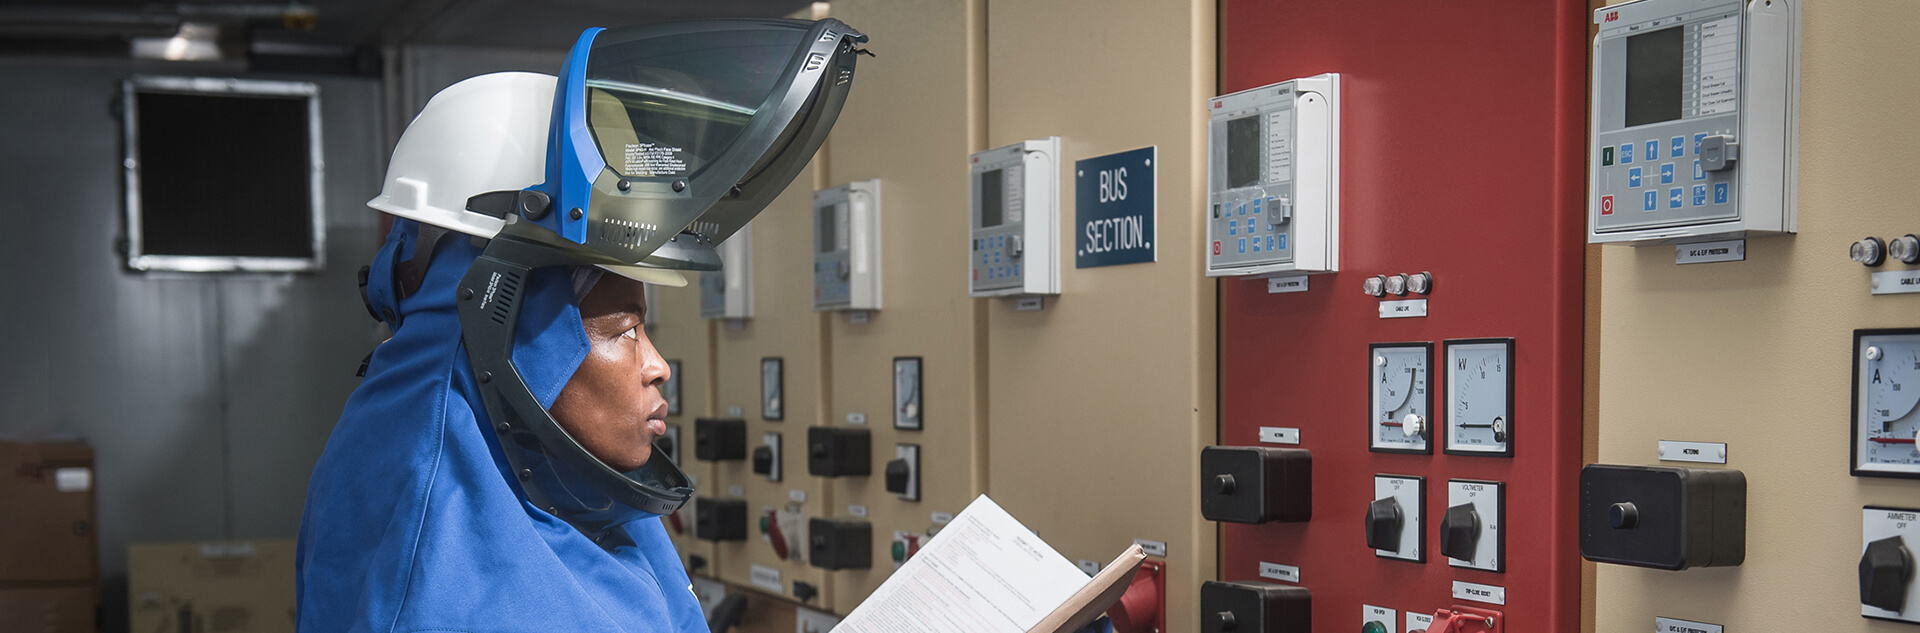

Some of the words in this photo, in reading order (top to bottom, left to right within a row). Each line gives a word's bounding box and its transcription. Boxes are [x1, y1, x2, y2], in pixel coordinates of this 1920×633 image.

[1605, 11, 1619, 23] ABB
[1214, 101, 1223, 109] ABB
[1621, 150, 1632, 158] ESC
[1100, 166, 1127, 203] BUS
[1085, 215, 1143, 254] SECTION
[1459, 358, 1467, 371] kV
[1497, 364, 1501, 372] 15
[1382, 371, 1387, 384] A
[1481, 371, 1486, 379] 10
[1872, 368, 1882, 384] A
[1892, 383, 1901, 391] 150
[1465, 402, 1469, 410] 5
[1462, 484, 1484, 492] VOLTMETER
[1887, 512, 1917, 521] AMMETER
